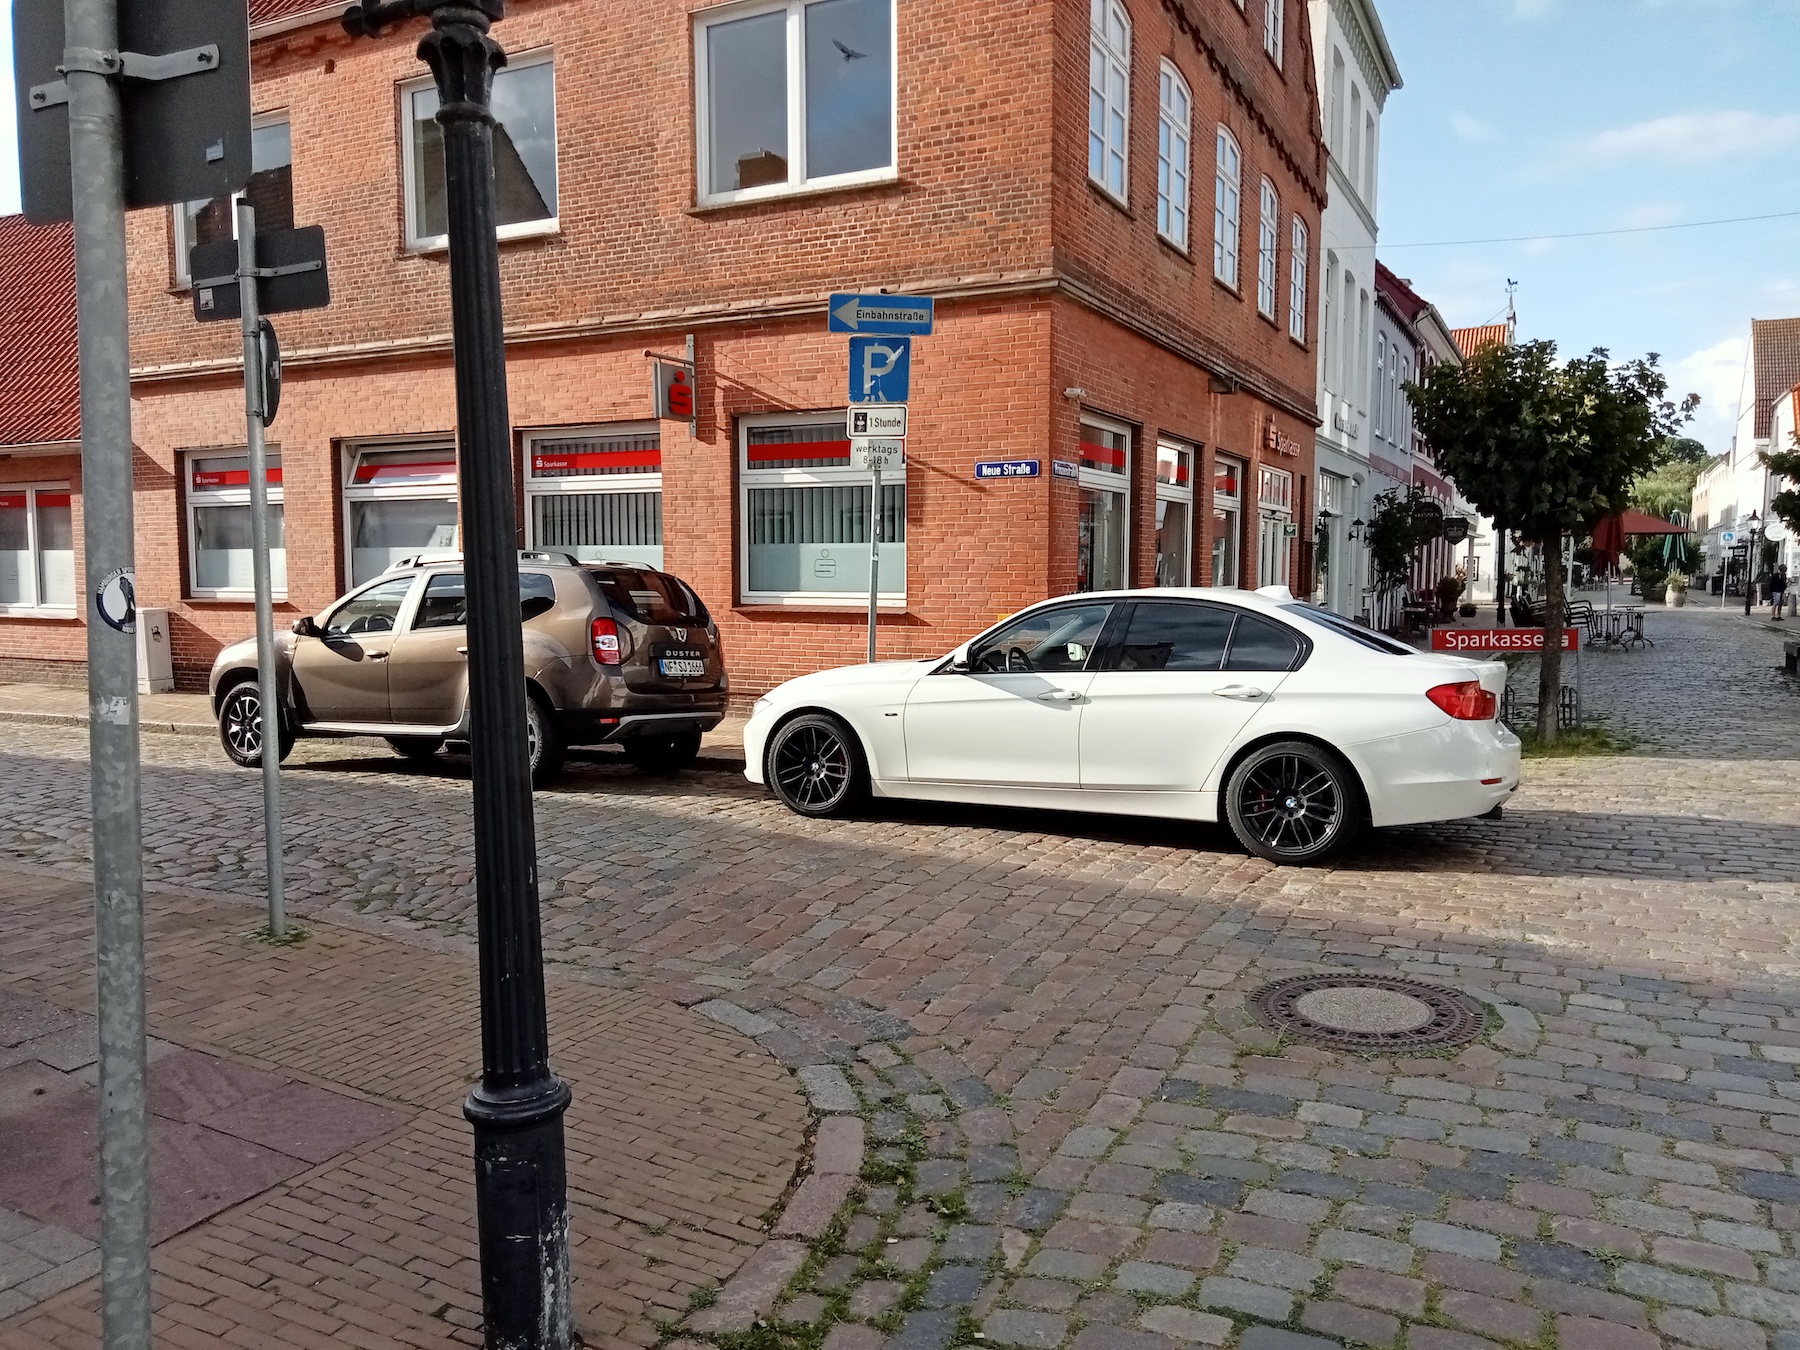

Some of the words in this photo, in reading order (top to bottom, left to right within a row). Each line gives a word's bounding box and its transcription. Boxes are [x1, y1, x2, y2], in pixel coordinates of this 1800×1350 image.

[856, 309, 924, 321] Einbahnstraße
[863, 345, 896, 395] P
[869, 419, 873, 428] 1
[874, 418, 901, 428] Stunde
[855, 444, 898, 456] werktags
[862, 455, 882, 465] 8-18
[884, 456, 889, 465] h
[982, 465, 1001, 476] Neue
[1003, 463, 1031, 475] Straße
[1445, 630, 1544, 650] Sparkasse
